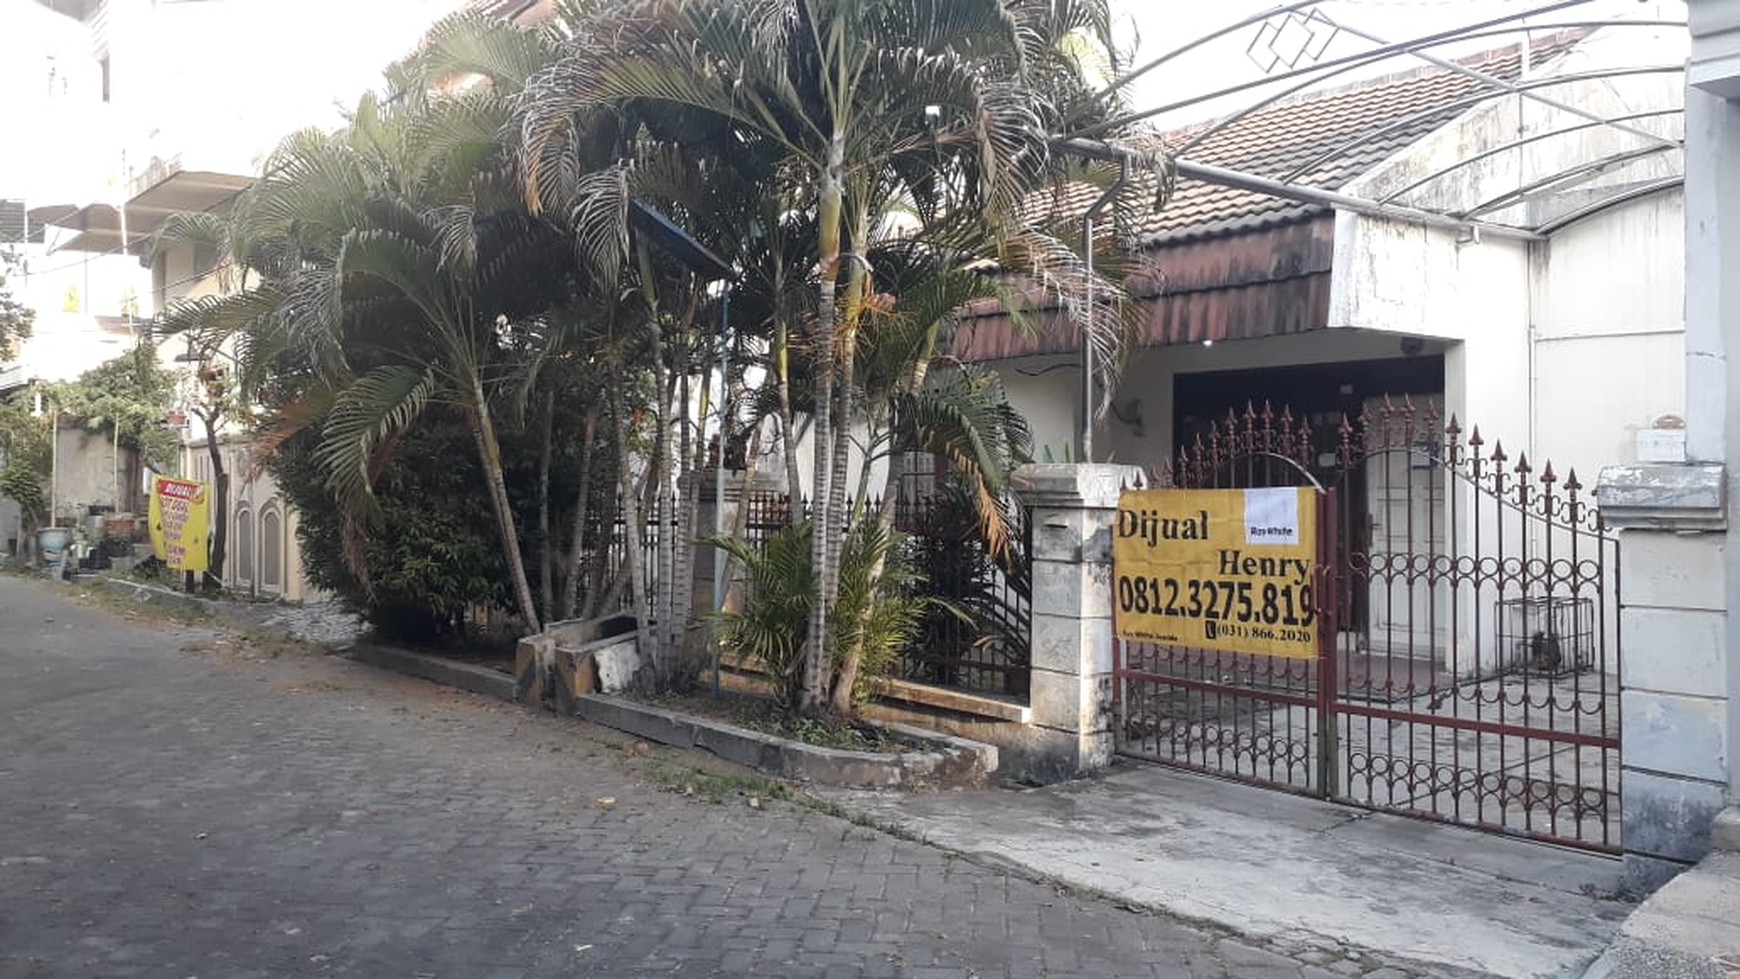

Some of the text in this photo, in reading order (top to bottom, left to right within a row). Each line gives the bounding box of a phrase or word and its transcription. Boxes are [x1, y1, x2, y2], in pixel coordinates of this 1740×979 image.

[1118, 510, 1208, 547] Dijual
[1250, 526, 1293, 537] Ray White
[1218, 549, 1310, 585] Henry
[1119, 575, 1315, 627] 0812.3275.819
[1217, 624, 1311, 642] (031) 866.2020
